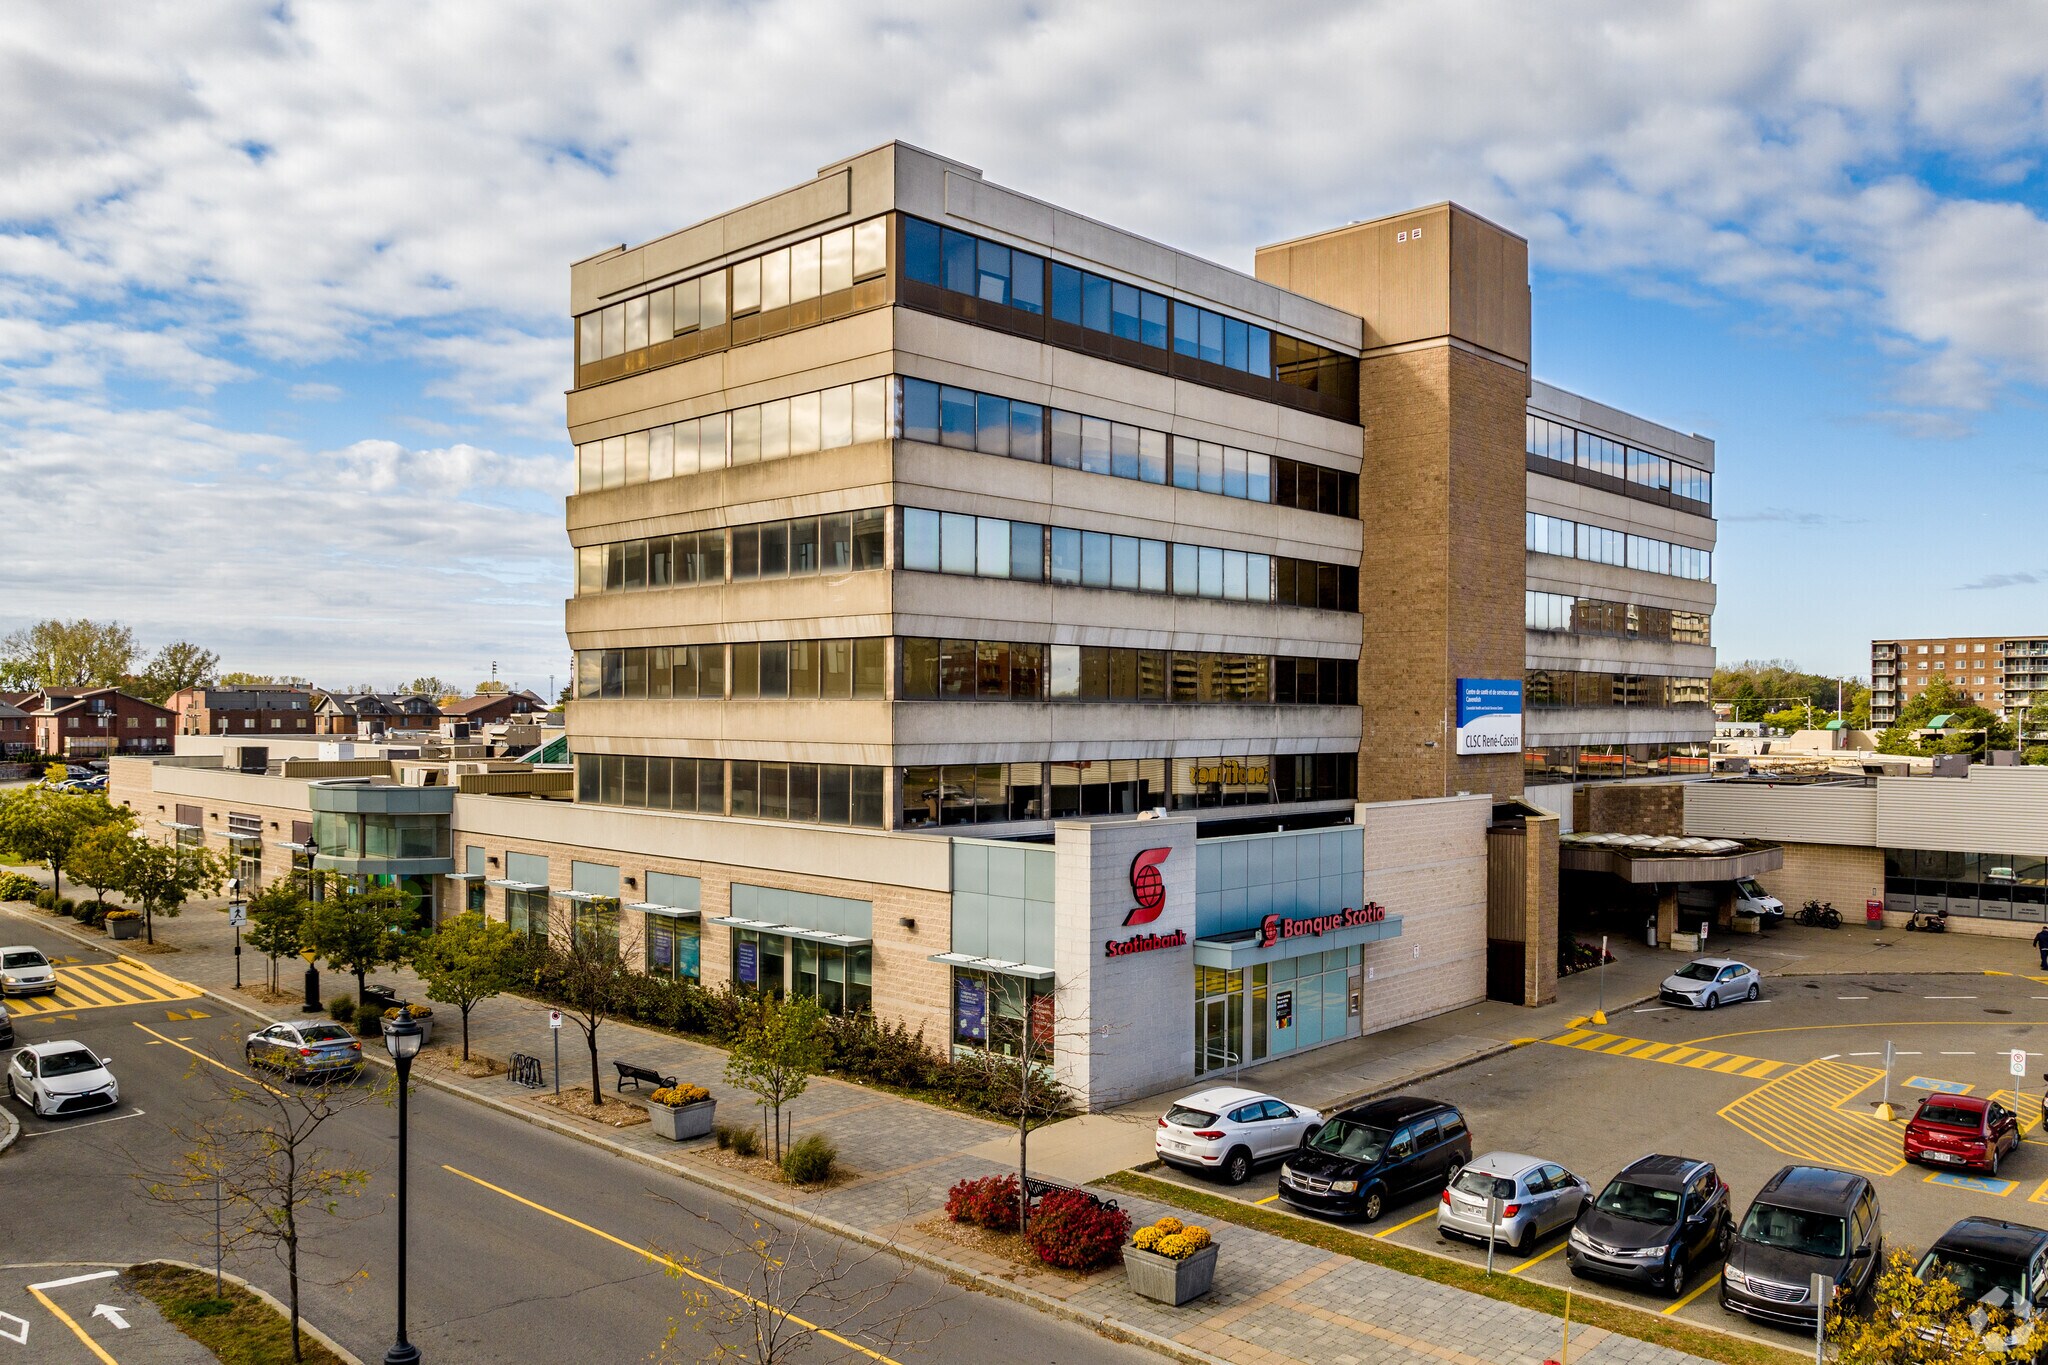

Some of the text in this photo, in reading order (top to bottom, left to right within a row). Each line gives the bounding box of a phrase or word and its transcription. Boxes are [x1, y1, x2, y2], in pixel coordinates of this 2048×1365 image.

[1466, 734, 1519, 748] CLSC René-Cassin
[1280, 902, 1386, 938] Banque Scotia
[1105, 929, 1187, 957] Scotiabank
